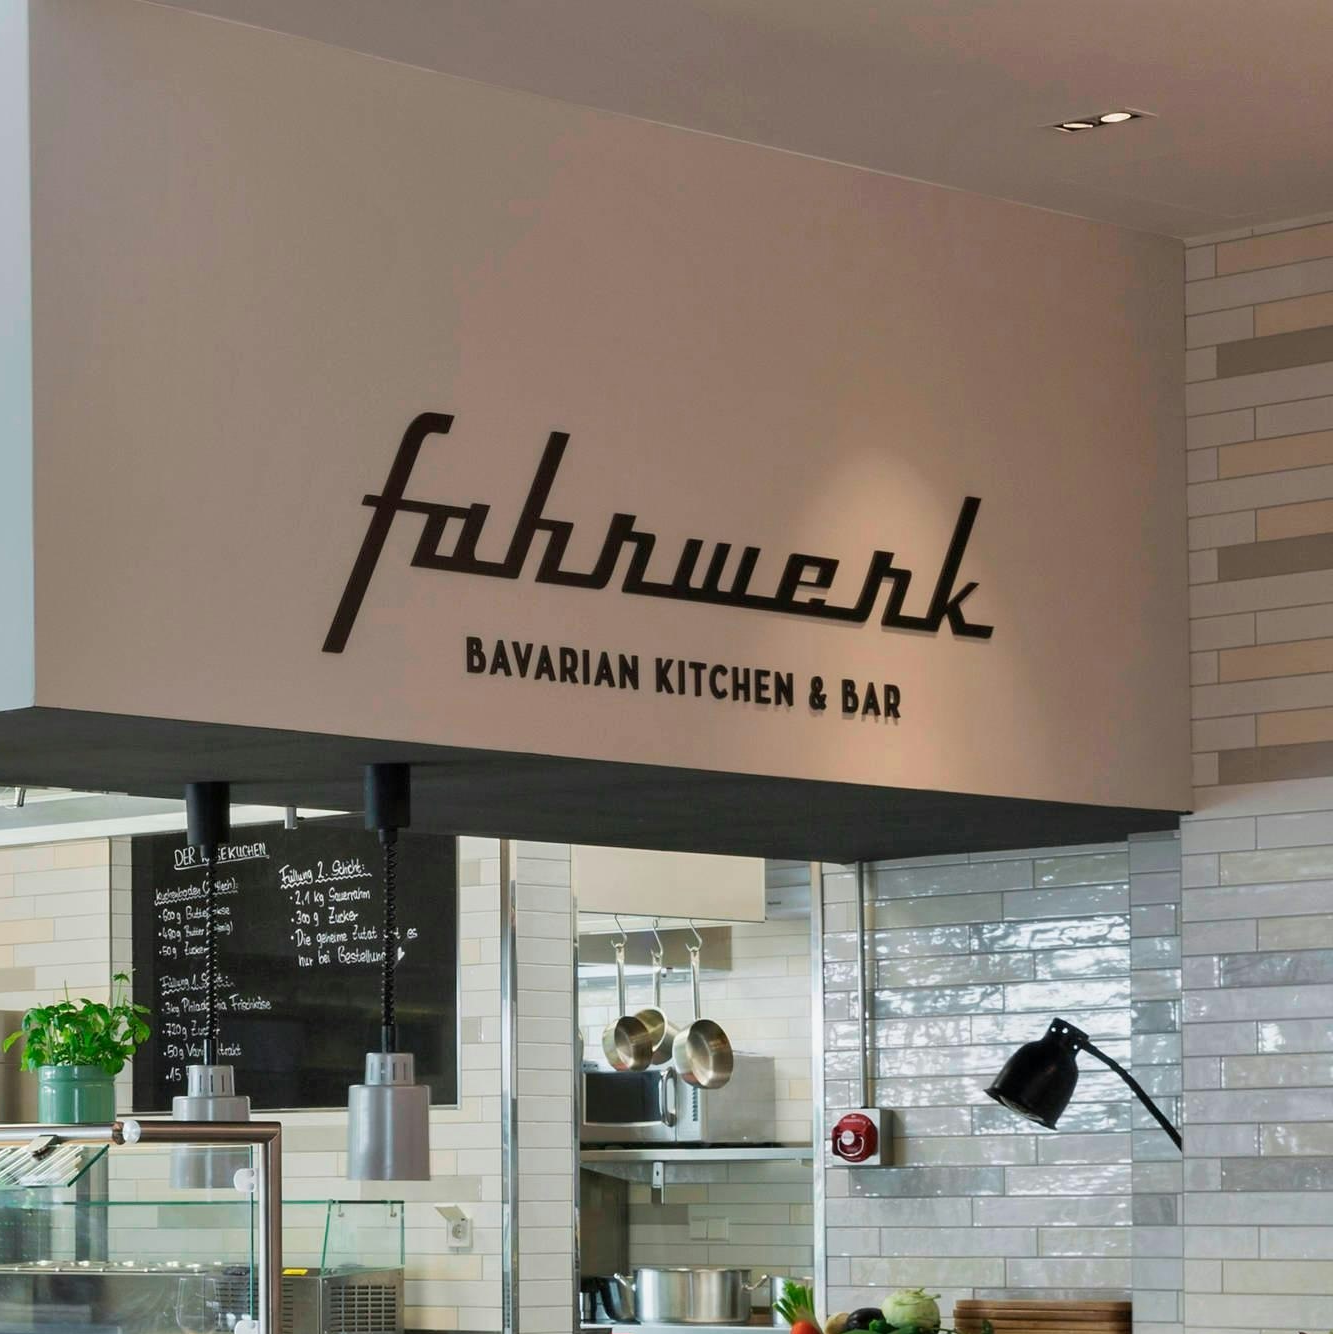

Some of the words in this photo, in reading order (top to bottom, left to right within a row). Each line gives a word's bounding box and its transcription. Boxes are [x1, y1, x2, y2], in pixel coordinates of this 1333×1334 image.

[322, 411, 994, 654] fahrwerk
[465, 636, 640, 692] BAVARIAN
[655, 657, 795, 708] KITCHEN
[808, 675, 828, 711] &
[841, 678, 903, 720] BAR
[174, 846, 196, 866] DER
[328, 906, 359, 924] Zucker
